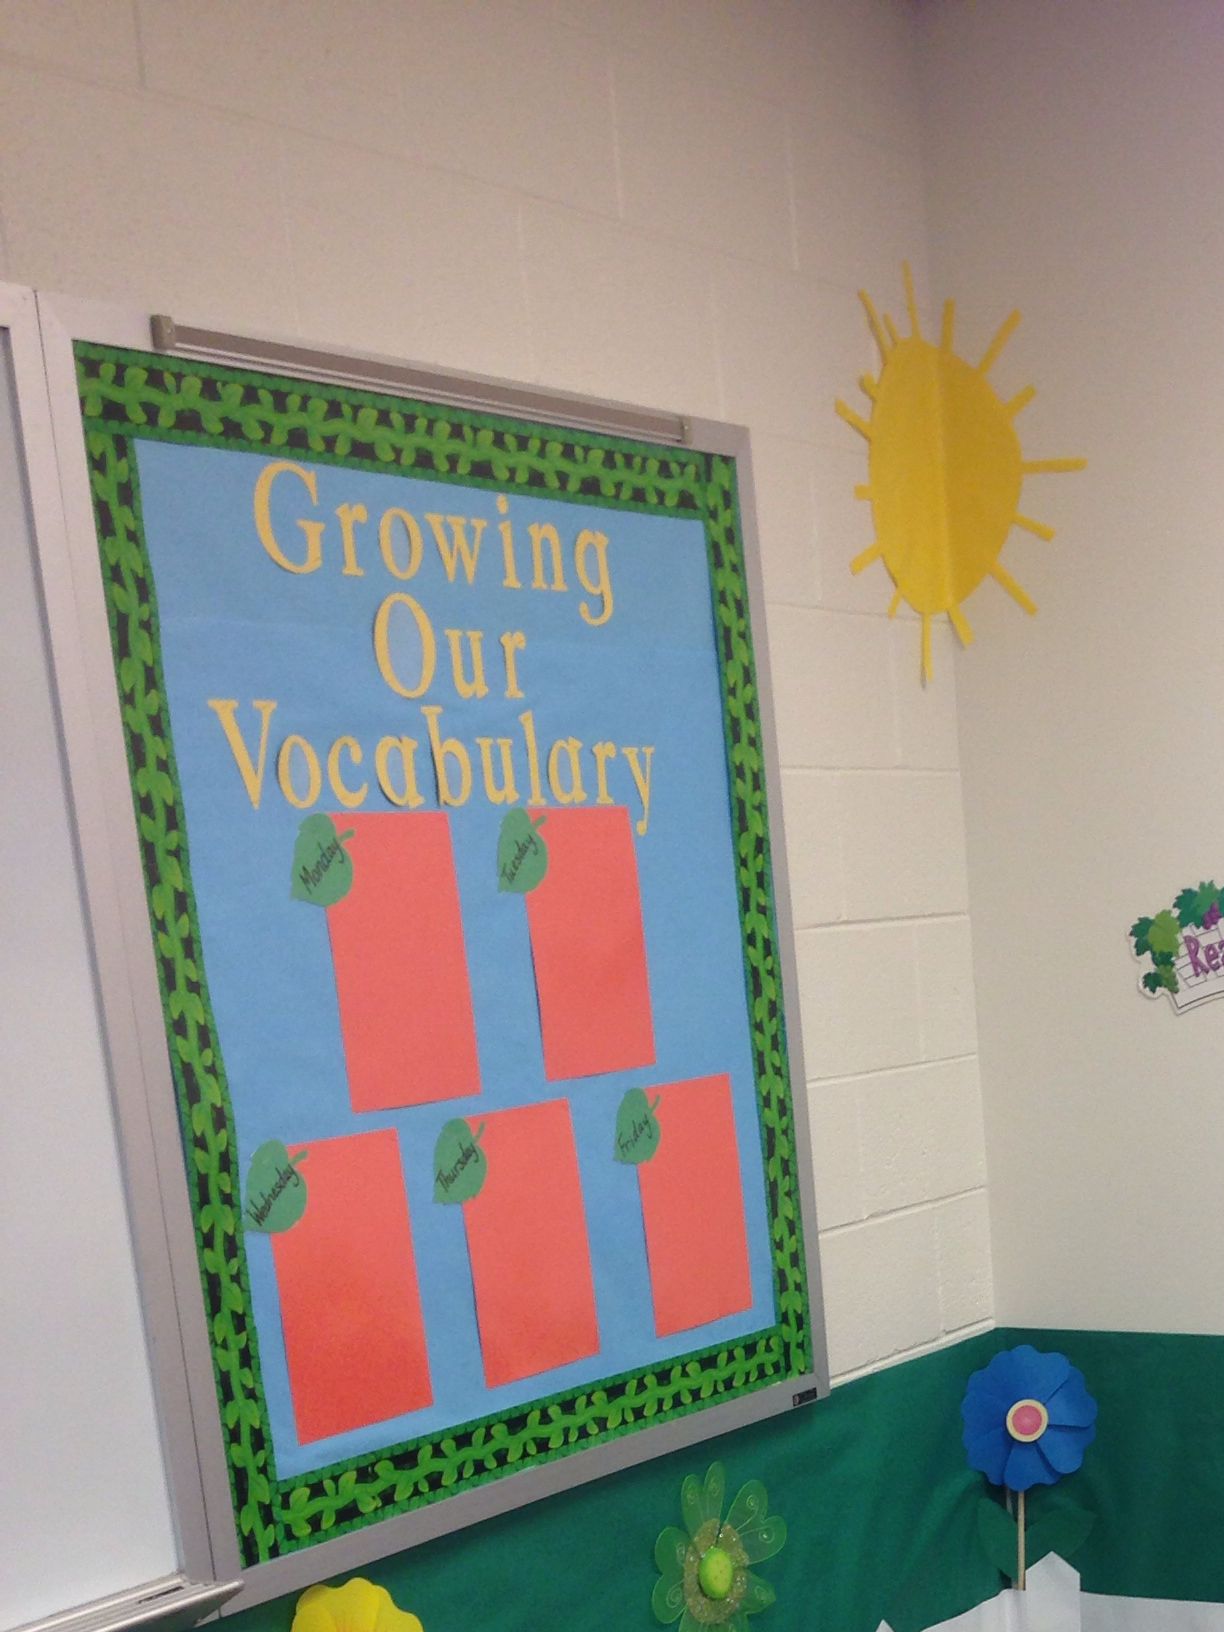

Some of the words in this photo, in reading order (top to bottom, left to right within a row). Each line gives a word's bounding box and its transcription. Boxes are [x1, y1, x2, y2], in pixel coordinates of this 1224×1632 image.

[253, 461, 614, 626] Growing
[373, 592, 526, 698] Our
[208, 698, 655, 836] Vocabulary
[300, 836, 346, 895] Monday
[500, 834, 539, 885] Tuesday
[616, 1113, 652, 1157] Friday
[435, 1139, 480, 1192] Thursday
